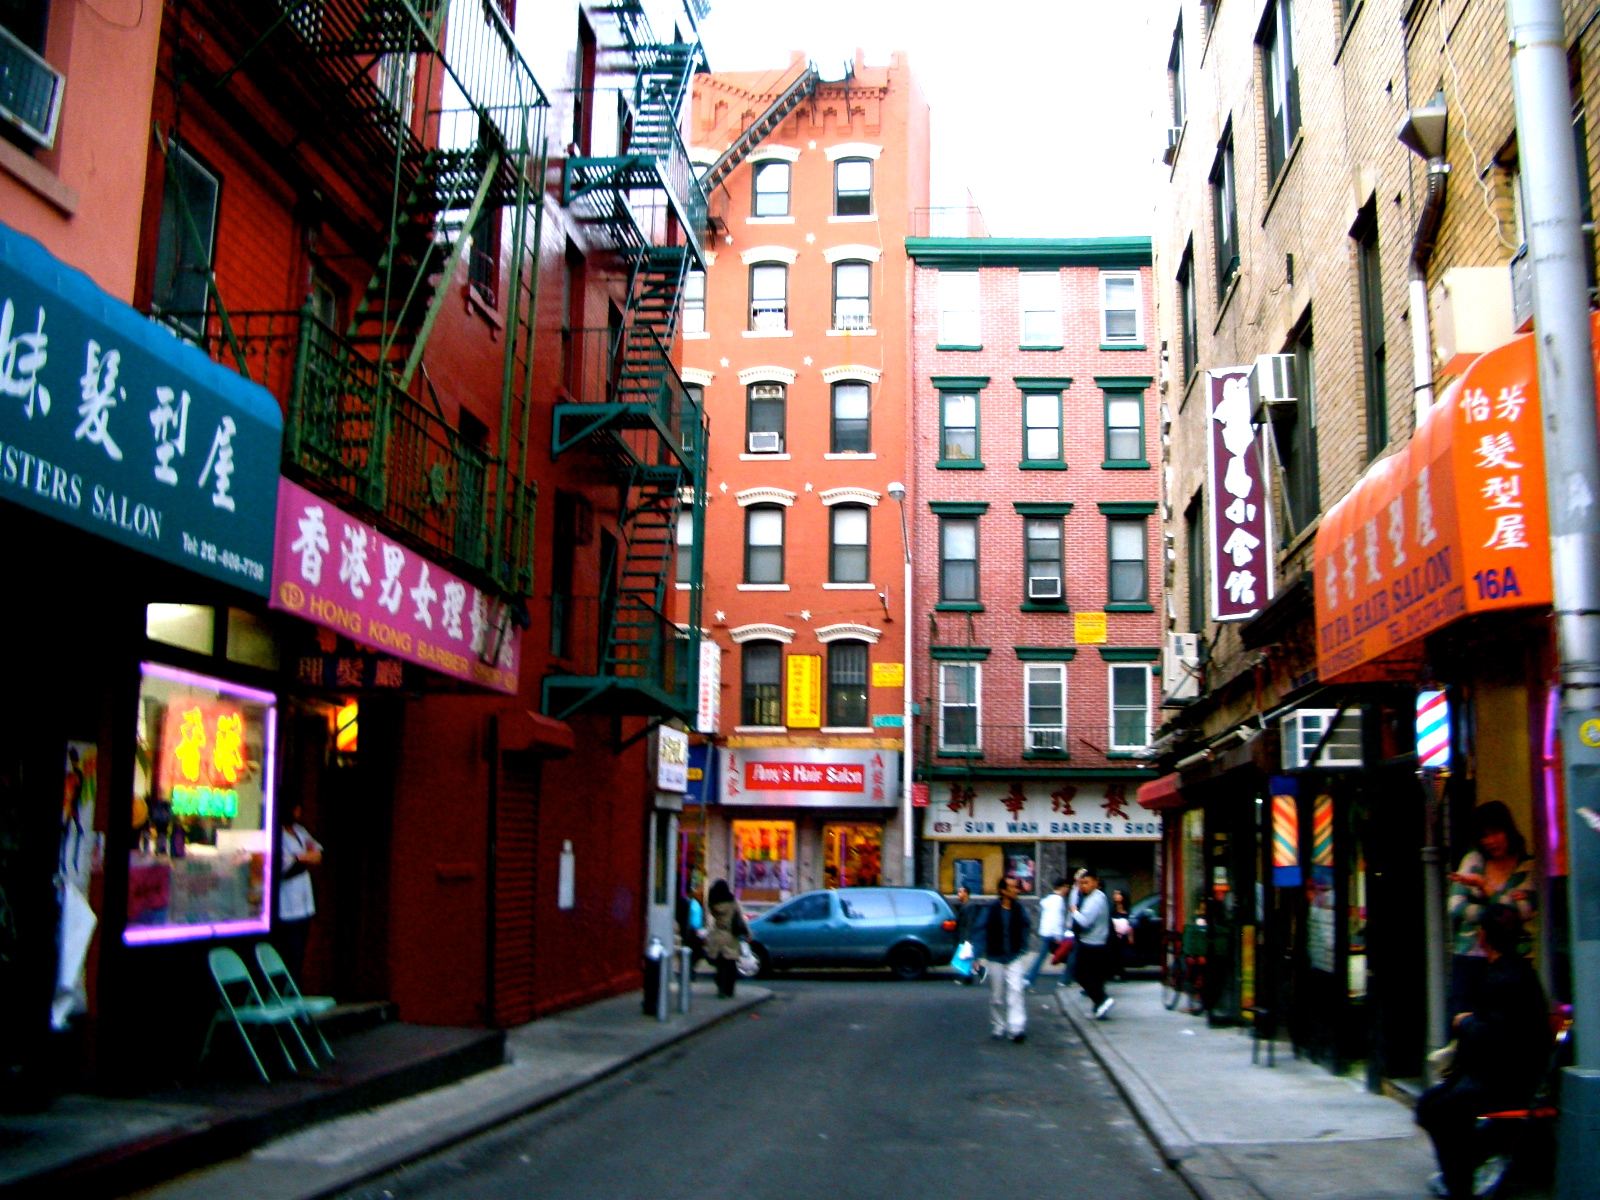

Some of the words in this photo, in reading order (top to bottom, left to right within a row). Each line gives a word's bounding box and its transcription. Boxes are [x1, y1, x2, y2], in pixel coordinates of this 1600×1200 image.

[1459, 383, 1527, 424] 怡芳
[0, 441, 82, 509] STERS
[92, 484, 161, 541] SALON
[1473, 431, 1530, 550] 髮型屋
[1472, 566, 1521, 600] 16A
[310, 594, 362, 634] HONG
[368, 619, 412, 654] KONG
[417, 640, 469, 675] BARBER
[793, 765, 823, 783] Hair
[826, 766, 862, 784] Salon
[947, 782, 1162, 821] 新華理髮
[964, 821, 995, 834] SUN
[1007, 822, 1039, 834] WAH
[1050, 822, 1112, 834] BARBER
